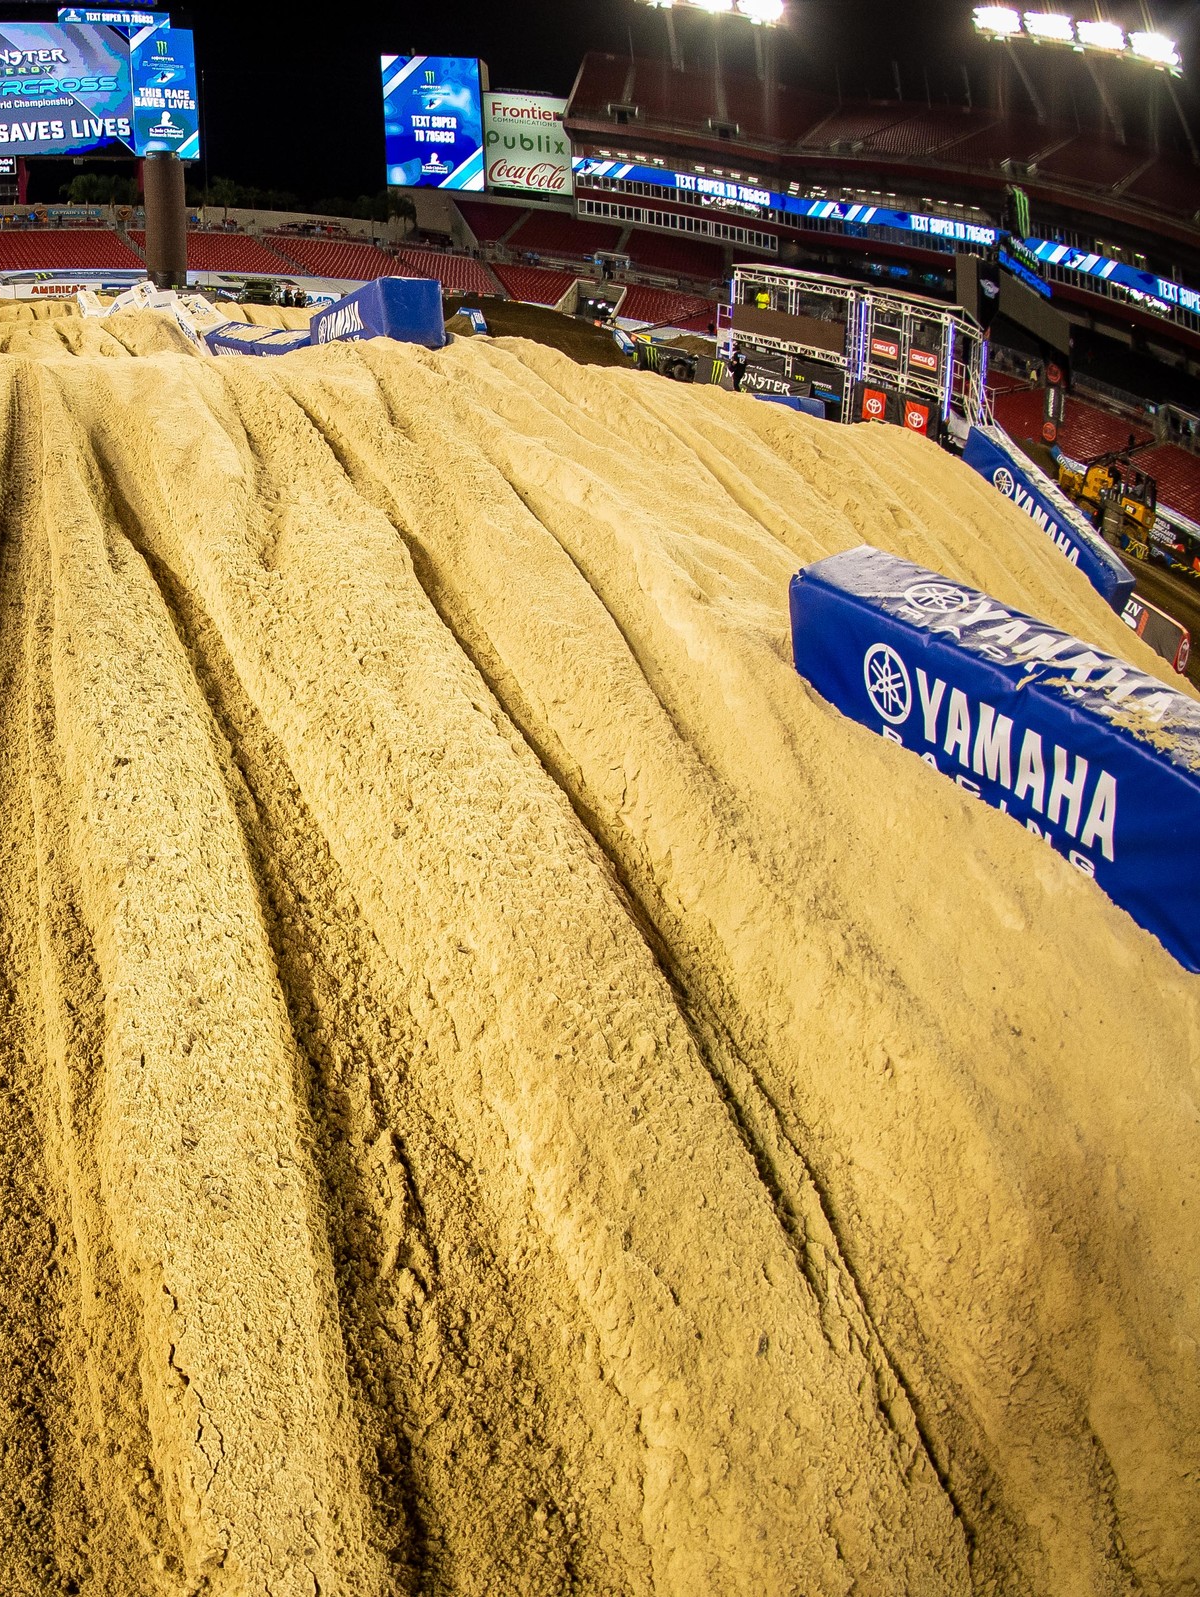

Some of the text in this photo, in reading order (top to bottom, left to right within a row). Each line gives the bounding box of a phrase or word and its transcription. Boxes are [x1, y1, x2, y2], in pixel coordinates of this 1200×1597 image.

[86, 12, 102, 22] TEXT
[102, 12, 122, 22] SUPER
[122, 14, 130, 23] TO
[139, 88, 190, 99] THIS RACE
[14, 97, 74, 109] Championship
[134, 97, 195, 110] SAVES LIVES
[491, 102, 561, 121] Frontier
[70, 118, 130, 139] LIVES
[411, 115, 457, 129] TEXT SUPER
[492, 117, 557, 128] COMMUNICATIONS
[414, 130, 425, 142] TO
[488, 159, 570, 190] Coca-Cola
[674, 174, 696, 190] TEXT
[697, 178, 725, 196] SUPER
[726, 184, 737, 198] TO
[910, 214, 929, 232] TEXT
[930, 218, 954, 236] SUPER
[955, 223, 965, 239] TO
[1157, 279, 1178, 302] TEXT
[326, 301, 364, 341] YAMAHA
[874, 344, 888, 352] CIRCLE
[912, 354, 927, 363] CIRCLE
[1014, 483, 1080, 567] YAMAHA
[916, 667, 1118, 862] YAMAHA
